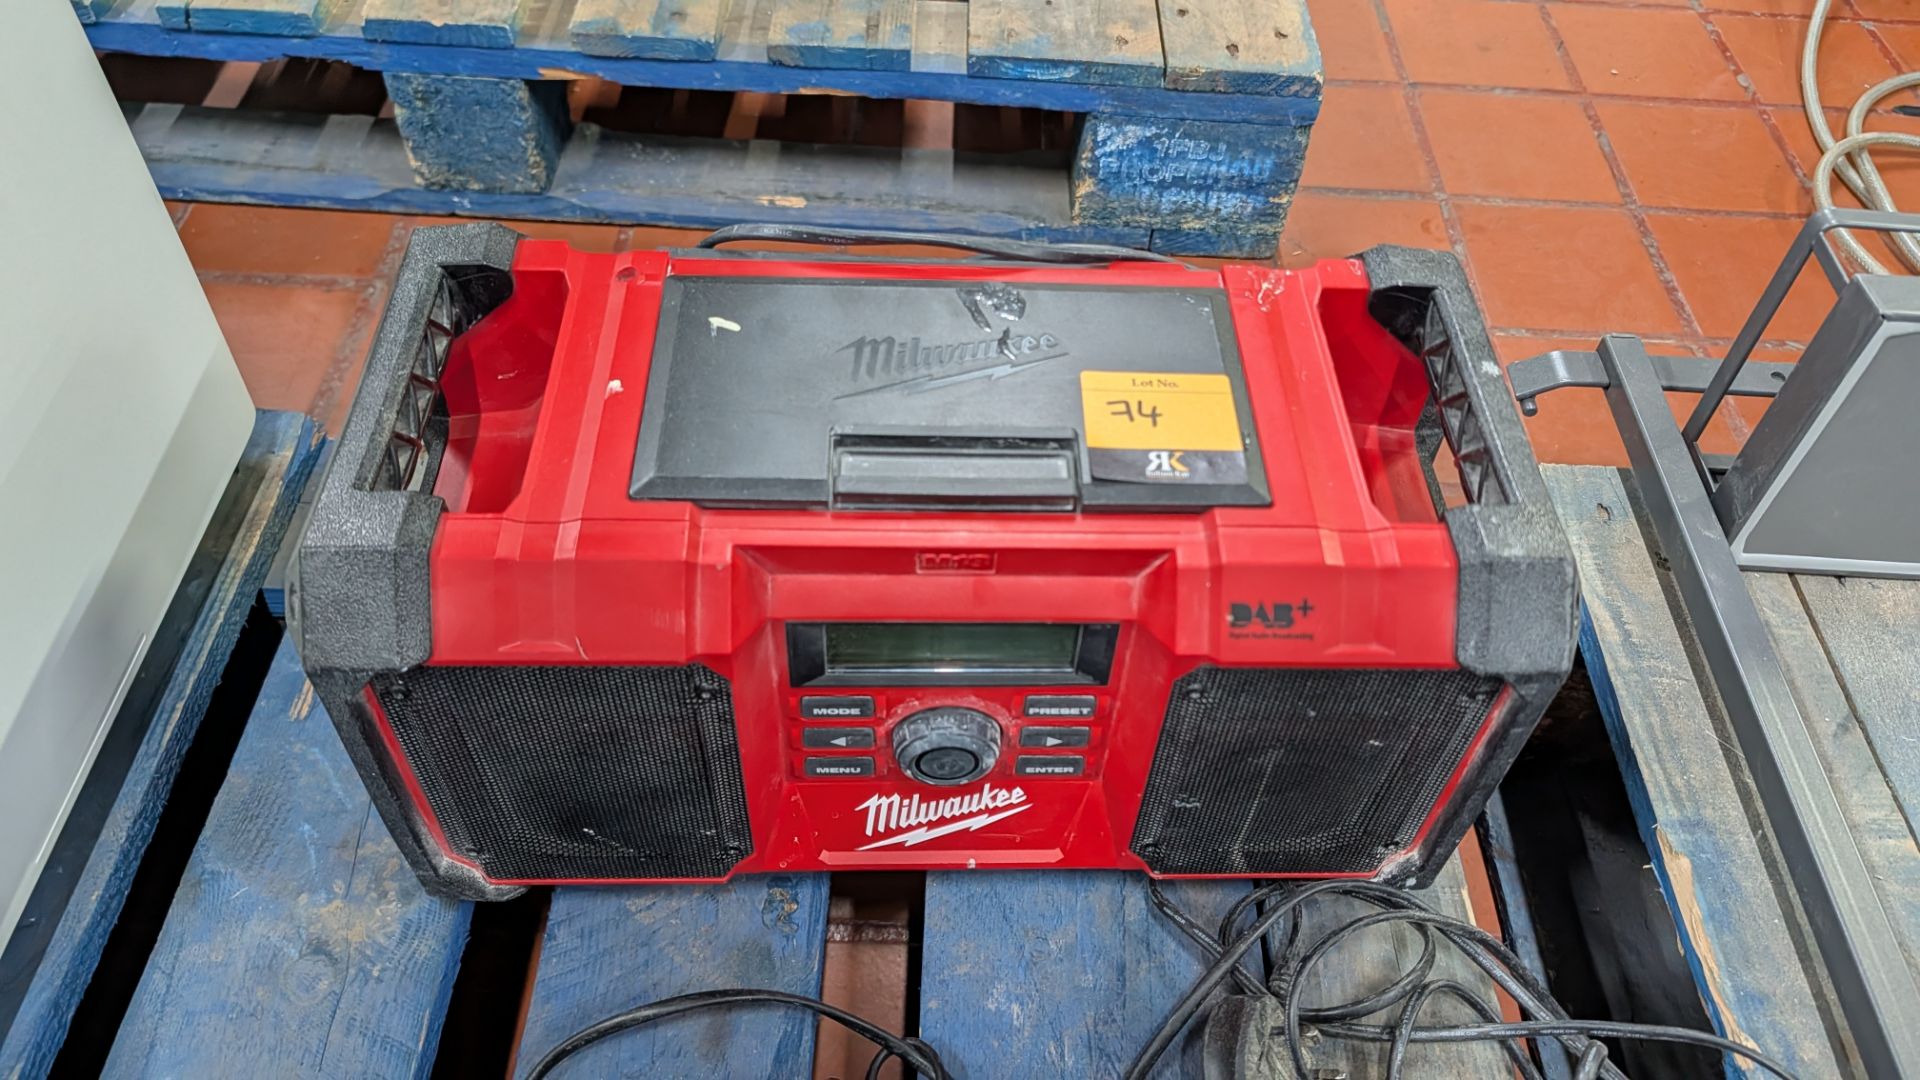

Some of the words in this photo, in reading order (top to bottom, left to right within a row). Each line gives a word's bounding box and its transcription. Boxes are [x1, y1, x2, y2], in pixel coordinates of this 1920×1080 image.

[835, 334, 1059, 382] Milwaukee
[1131, 378, 1153, 387] Lot
[1157, 379, 1179, 388] No.
[1106, 400, 1163, 428] 74
[812, 707, 861, 716] MODE
[1028, 707, 1091, 716] PRESET
[815, 766, 861, 775] MENU
[1025, 766, 1074, 774] ENTER
[854, 783, 1028, 837] Milwaukee
